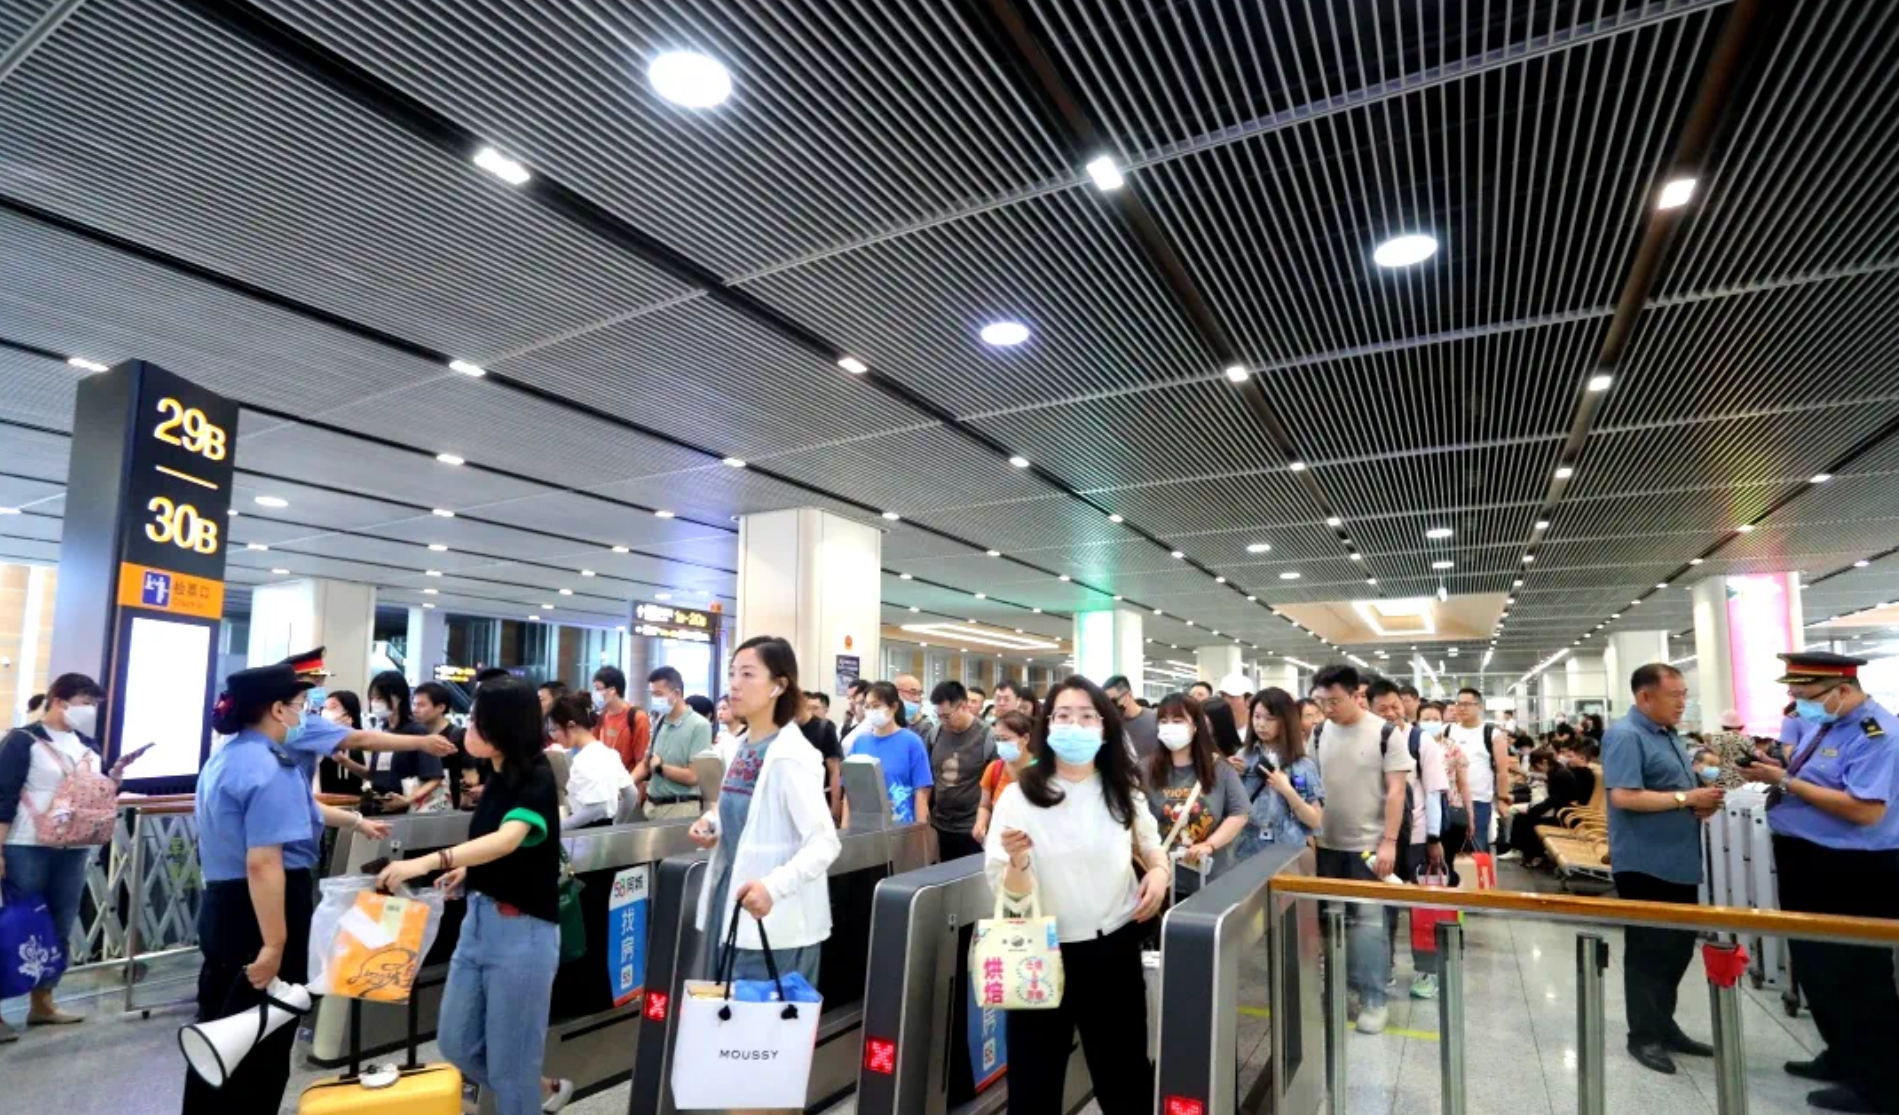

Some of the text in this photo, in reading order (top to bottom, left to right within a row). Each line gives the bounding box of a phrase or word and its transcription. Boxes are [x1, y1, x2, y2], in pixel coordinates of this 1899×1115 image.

[154, 397, 226, 461] 29B
[145, 496, 218, 554] 30B
[984, 956, 1003, 1004] 烘焙
[719, 1049, 779, 1061] MOUSSY
